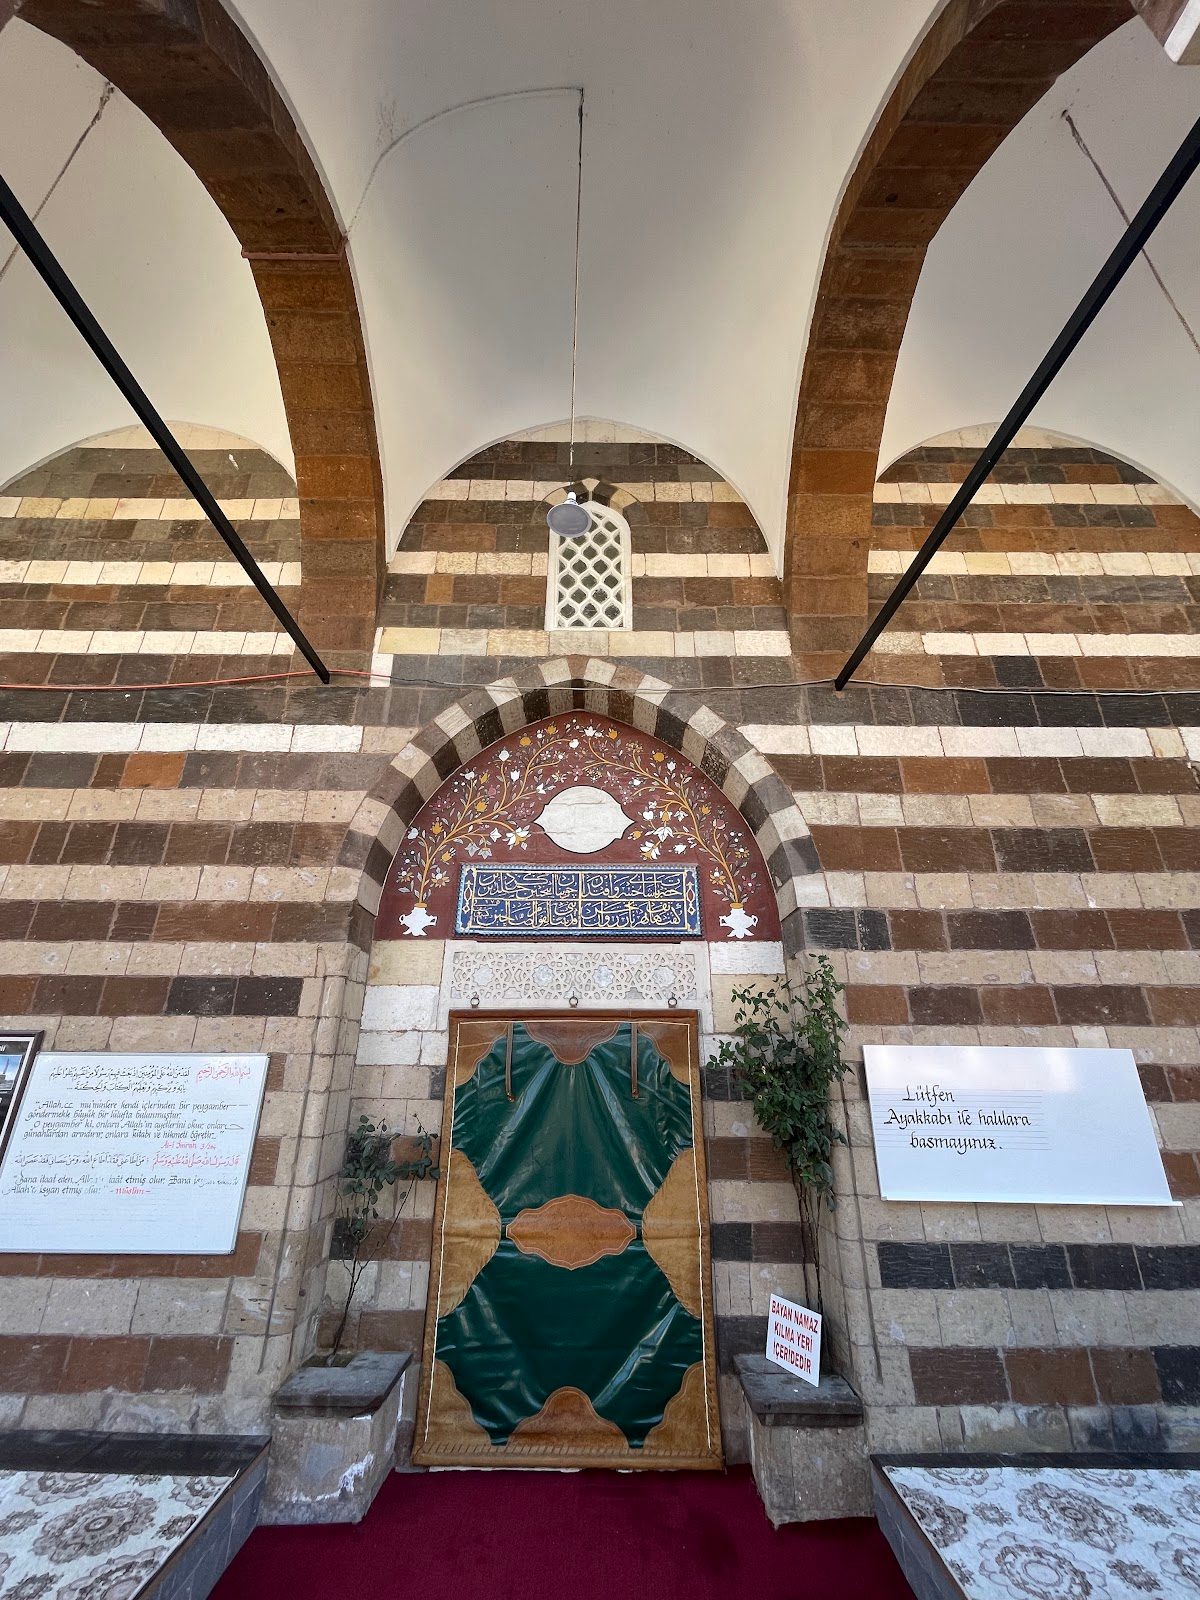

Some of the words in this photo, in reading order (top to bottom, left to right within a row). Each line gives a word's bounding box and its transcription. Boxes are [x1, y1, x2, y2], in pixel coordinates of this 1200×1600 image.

[902, 1085, 955, 1107] Lütfen
[883, 1109, 952, 1129] Ayakkabı
[957, 1110, 972, 1126] ile
[978, 1110, 1031, 1126] halılara
[910, 1131, 1003, 1155] basmayınız.
[771, 1300, 793, 1321] BAYAN
[794, 1310, 819, 1333] NAMAZ
[774, 1320, 794, 1343] KILMA
[796, 1332, 813, 1353] YERİ
[773, 1337, 812, 1374] İÇERİDEDİR
